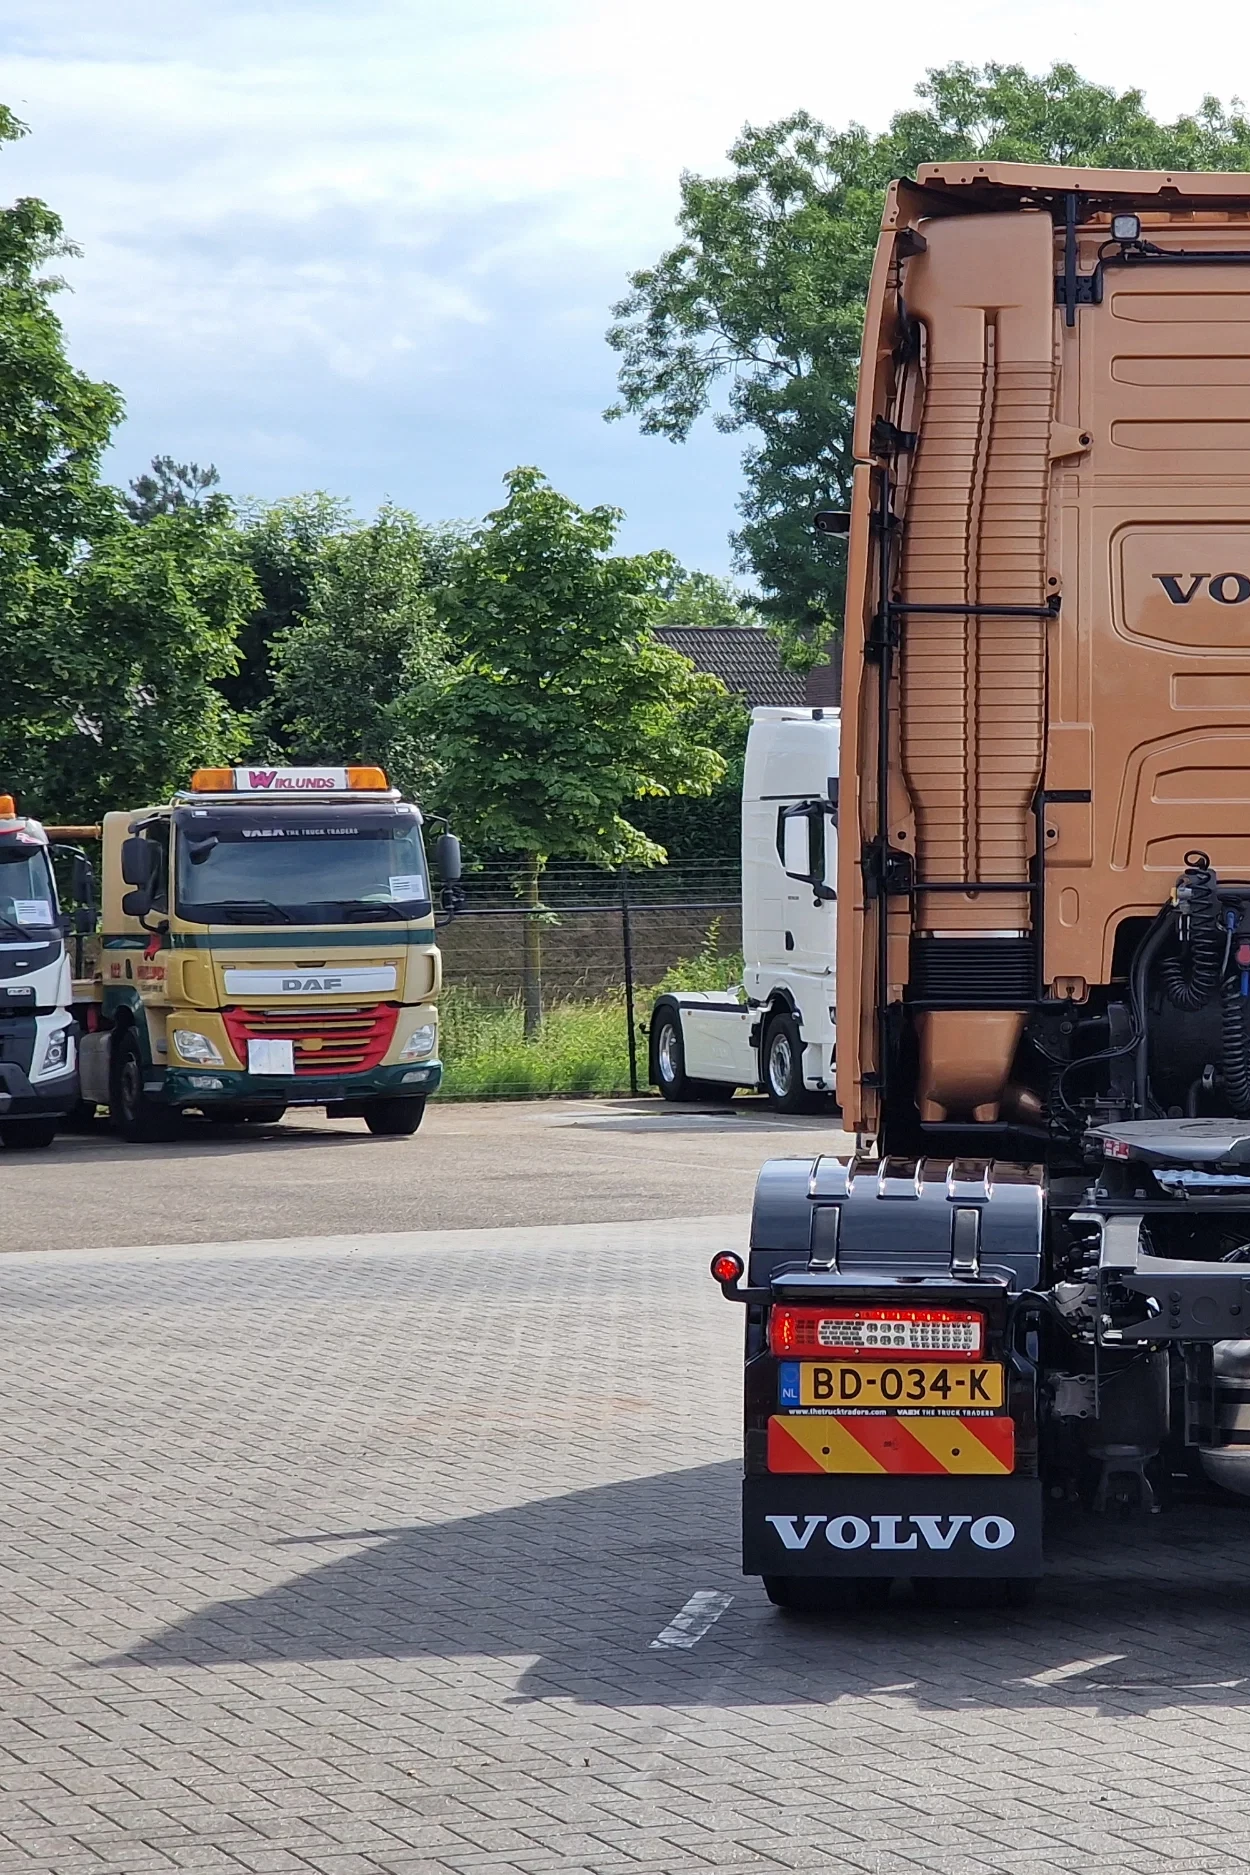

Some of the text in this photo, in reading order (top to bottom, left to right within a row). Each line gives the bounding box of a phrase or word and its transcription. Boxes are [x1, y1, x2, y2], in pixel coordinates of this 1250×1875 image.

[248, 770, 335, 789] WIKLUNDS
[282, 978, 342, 991] DAF
[813, 1367, 991, 1401] BD-034-K
[782, 1388, 797, 1398] NL
[788, 1408, 887, 1416] www.thetrucktraders.com
[765, 1515, 1015, 1550] VOLVO
